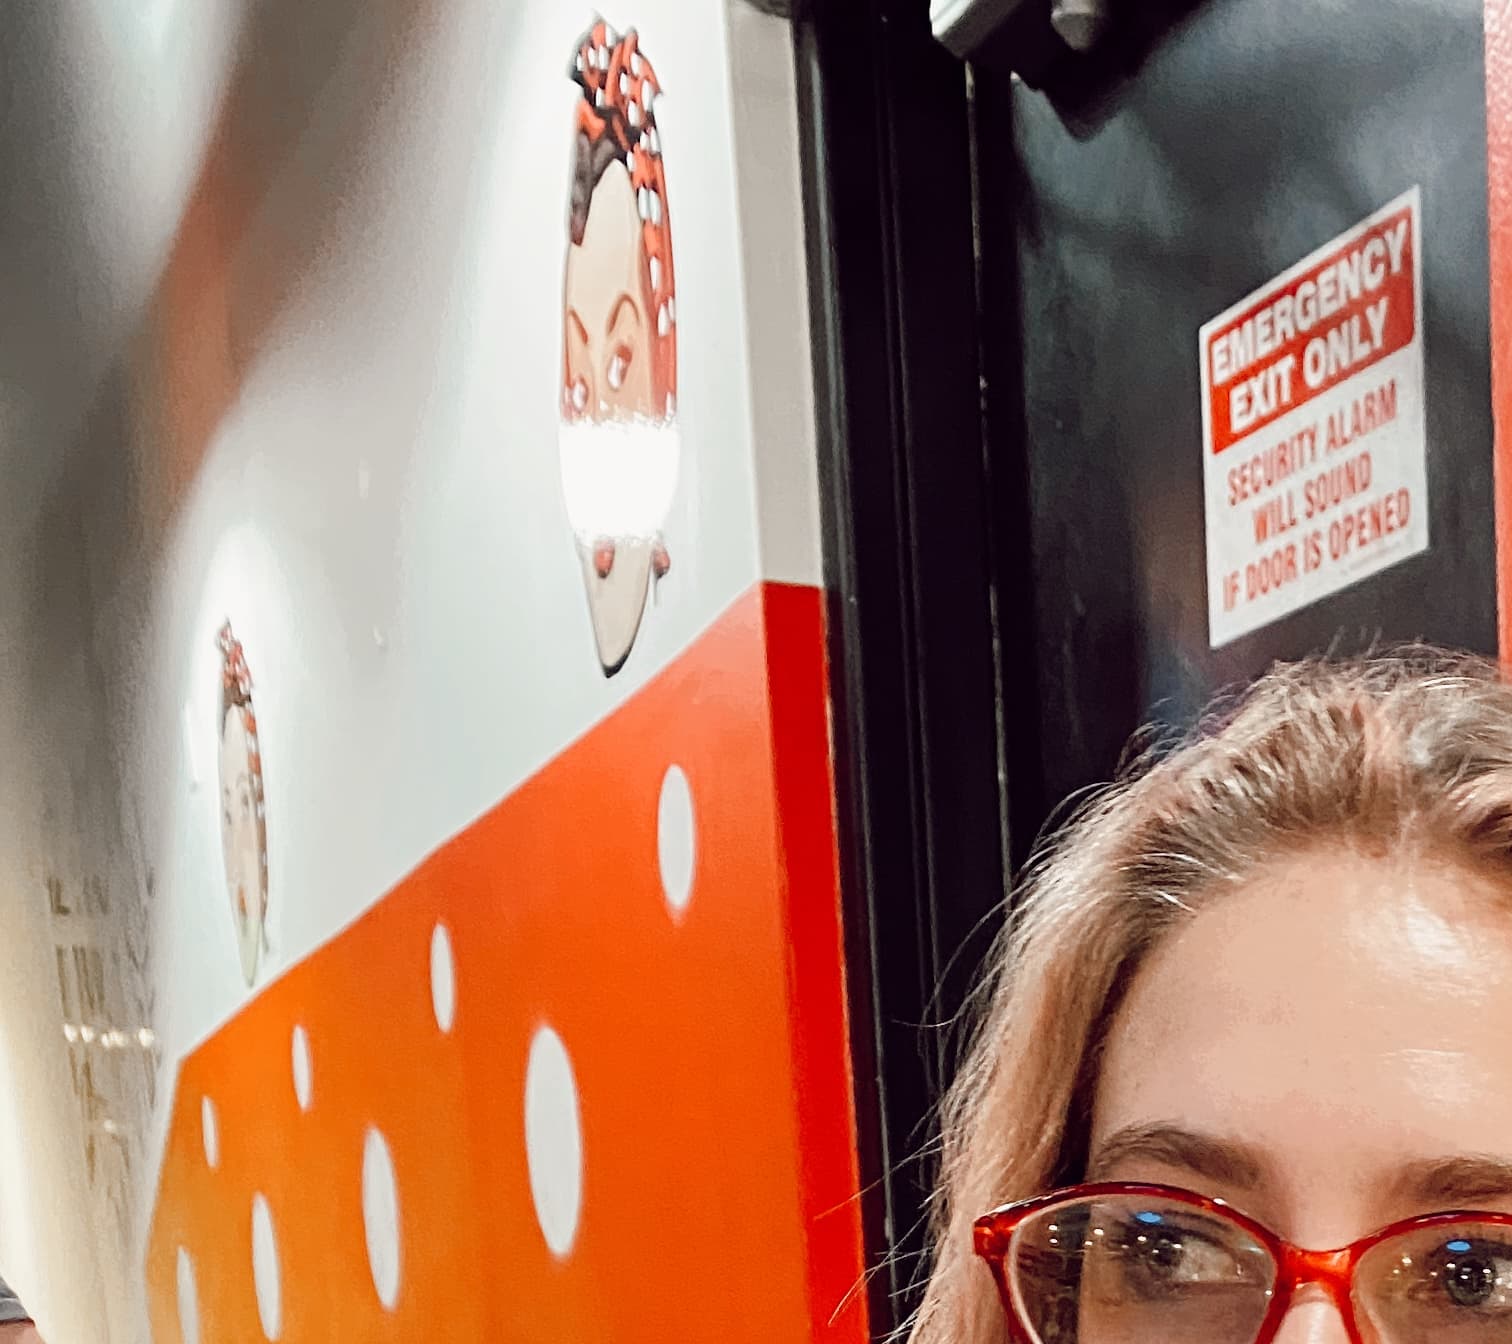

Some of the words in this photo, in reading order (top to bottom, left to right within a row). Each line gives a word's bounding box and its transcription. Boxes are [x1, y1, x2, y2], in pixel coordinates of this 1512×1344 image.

[1211, 219, 1408, 386] EMERGENCY
[1229, 356, 1295, 435] EXIT
[1303, 297, 1390, 387] ONLY
[1227, 425, 1320, 507] SECURITY
[1325, 379, 1398, 454] ALARM
[1252, 499, 1297, 544] WILL
[1303, 450, 1373, 522] SOUND
[1223, 570, 1240, 613] IF
[1245, 541, 1298, 597] DOOR
[1303, 534, 1322, 576] IS
[1329, 486, 1411, 562] OPENED
